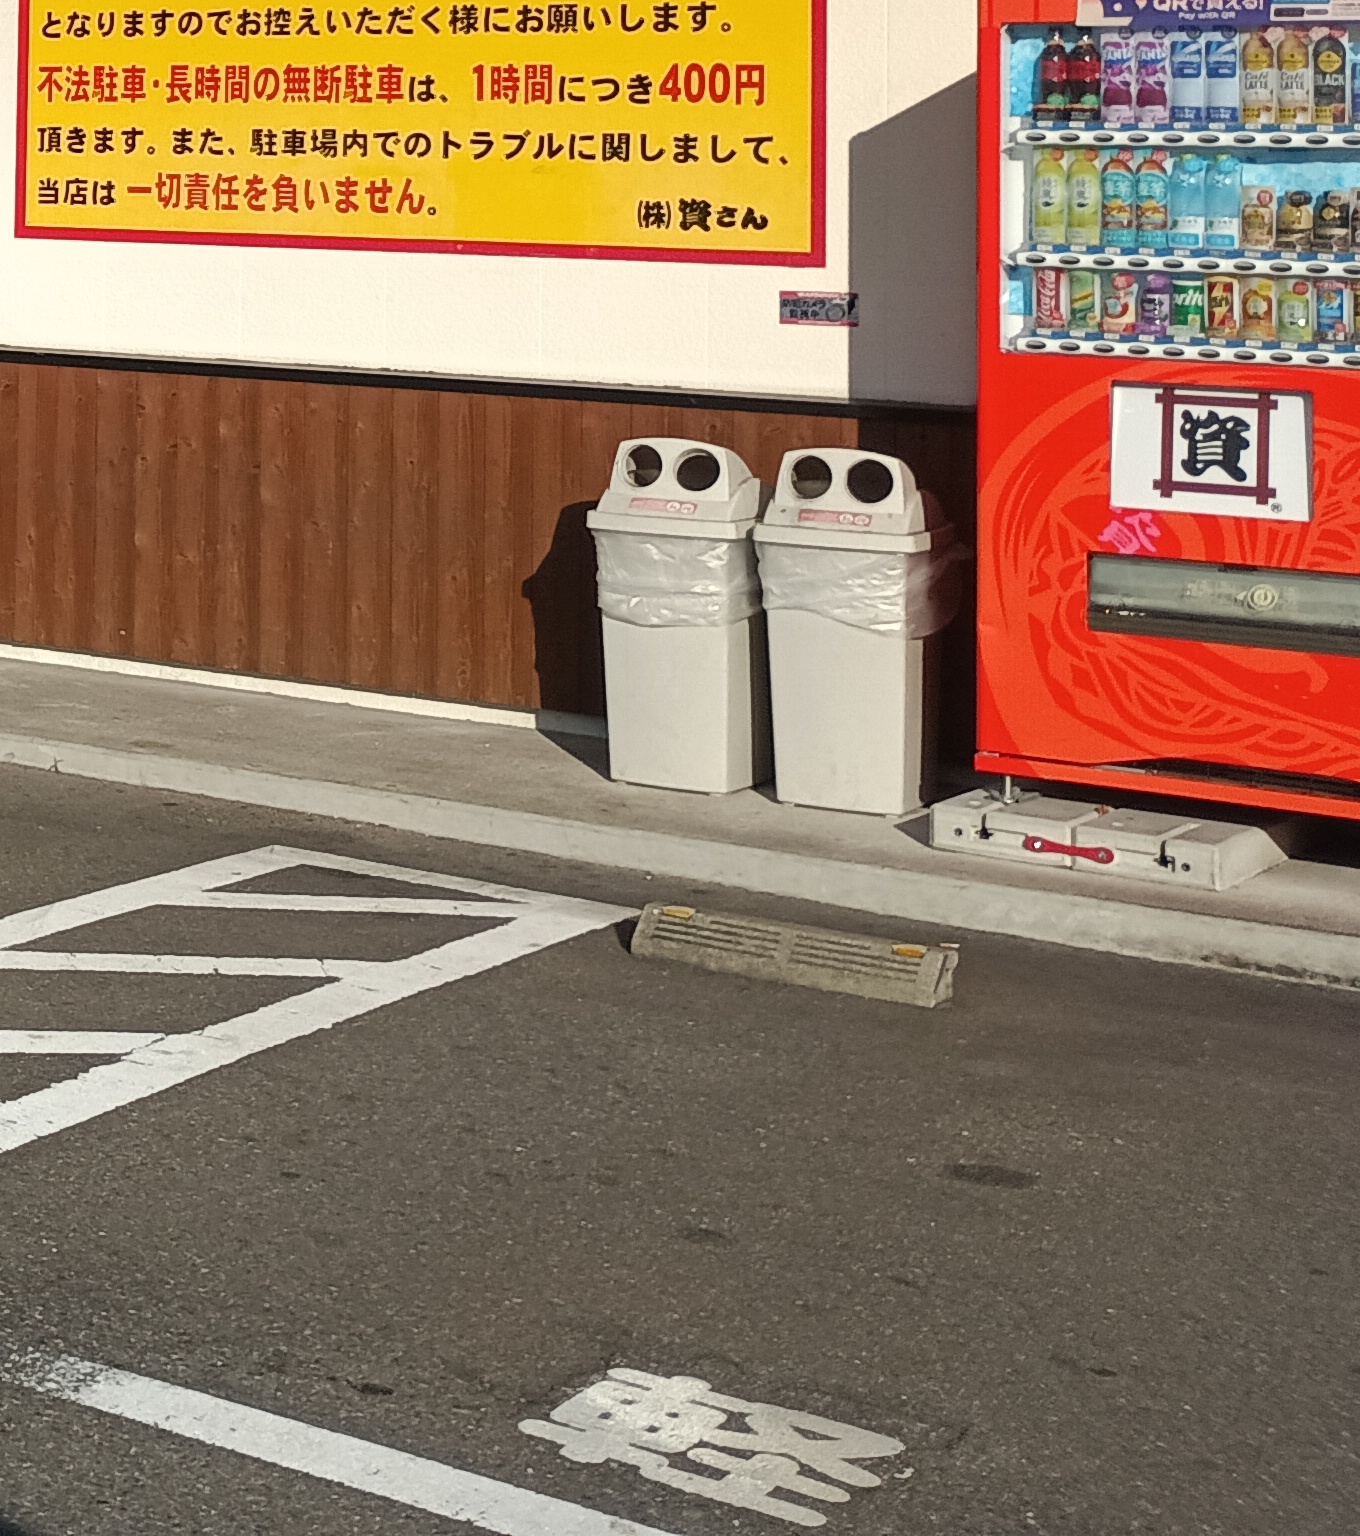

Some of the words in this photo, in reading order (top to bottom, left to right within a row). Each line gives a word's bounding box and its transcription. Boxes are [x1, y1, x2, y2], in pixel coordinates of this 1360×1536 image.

[40, 0, 734, 41] となりますのでお控えいただく様にお願いします。
[37, 126, 790, 165] 頂きます。また、駐車場内でのトラブルに関しまして、
[1180, 410, 1250, 482] 資
[517, 1367, 906, 1526] 軽
